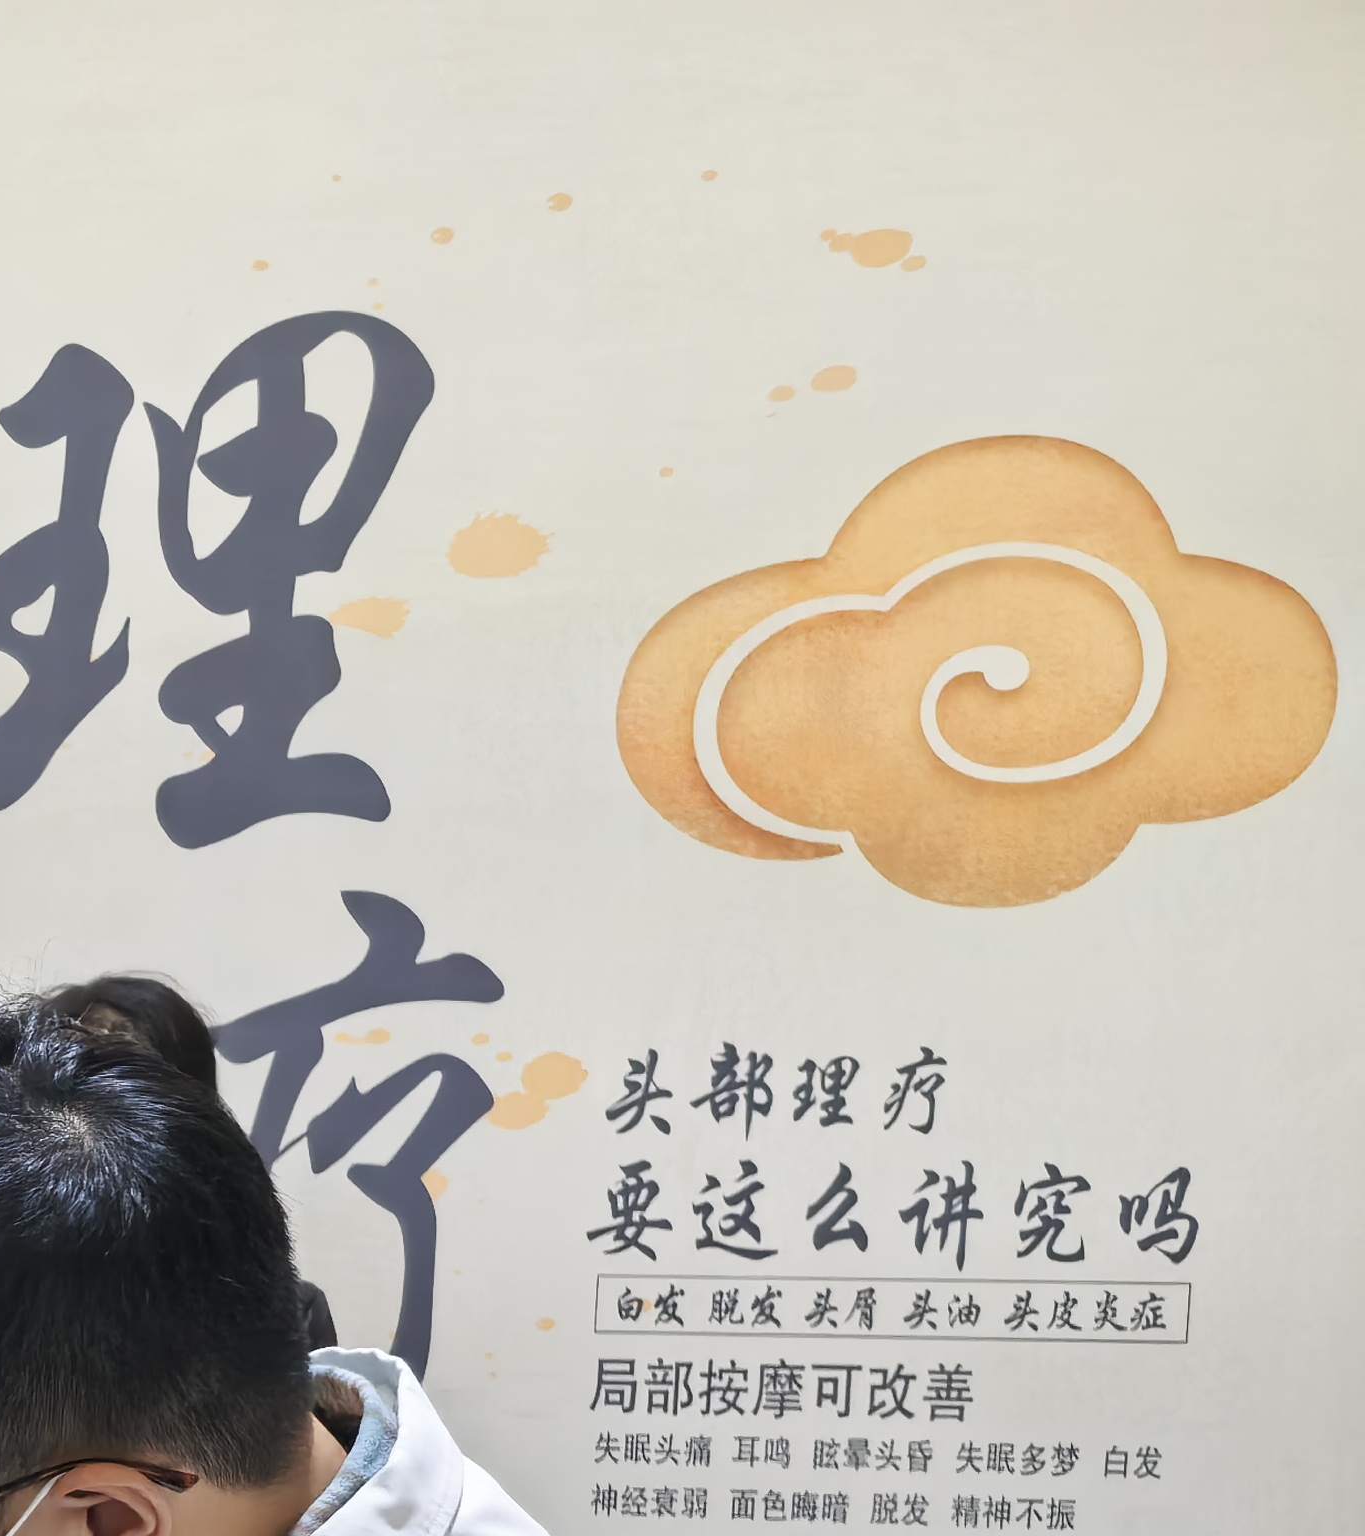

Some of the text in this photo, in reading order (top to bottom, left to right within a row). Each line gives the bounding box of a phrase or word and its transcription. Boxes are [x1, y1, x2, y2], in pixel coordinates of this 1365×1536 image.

[605, 1041, 948, 1141] 头部理疗
[586, 1159, 1200, 1272] 要这么讲究吗
[708, 1285, 783, 1328] 脱发
[804, 1286, 877, 1331] 头屑
[902, 1289, 982, 1331] 头油
[1003, 1290, 1167, 1332] 头皮炎症
[589, 1357, 974, 1423] 局部按摩可改善
[594, 1431, 713, 1468] 失眠头痛
[731, 1435, 791, 1470] 耳鸣
[955, 1440, 1080, 1478] 失眠多梦
[1103, 1444, 1163, 1480] 白发
[591, 1482, 708, 1520] 神经衰弱
[869, 1492, 930, 1527] 脱发
[951, 1493, 1077, 1532] 精神不振
